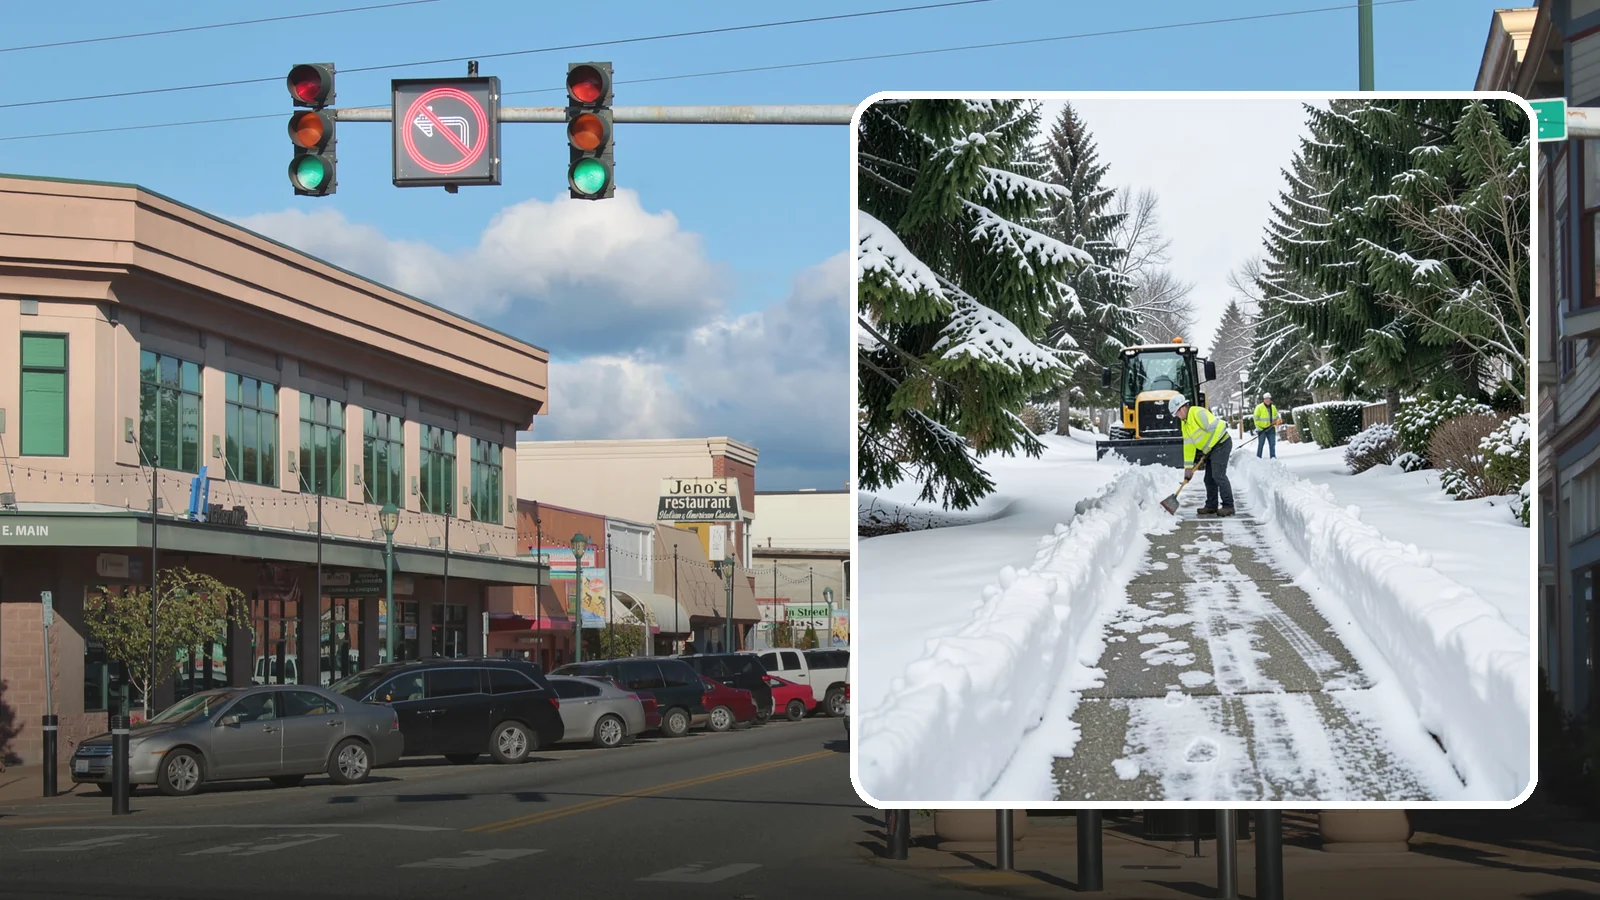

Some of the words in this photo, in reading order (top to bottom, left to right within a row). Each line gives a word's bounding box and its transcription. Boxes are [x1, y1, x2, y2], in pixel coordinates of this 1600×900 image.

[669, 480, 727, 494] Jeno's
[665, 497, 731, 509] restaurant
[658, 510, 681, 519] Italian
[686, 510, 714, 519] American
[715, 509, 737, 519] Cuisine
[2, 526, 13, 536] E.
[15, 525, 49, 536] MAIN
[797, 607, 829, 616] Street
[791, 619, 824, 627] lass
